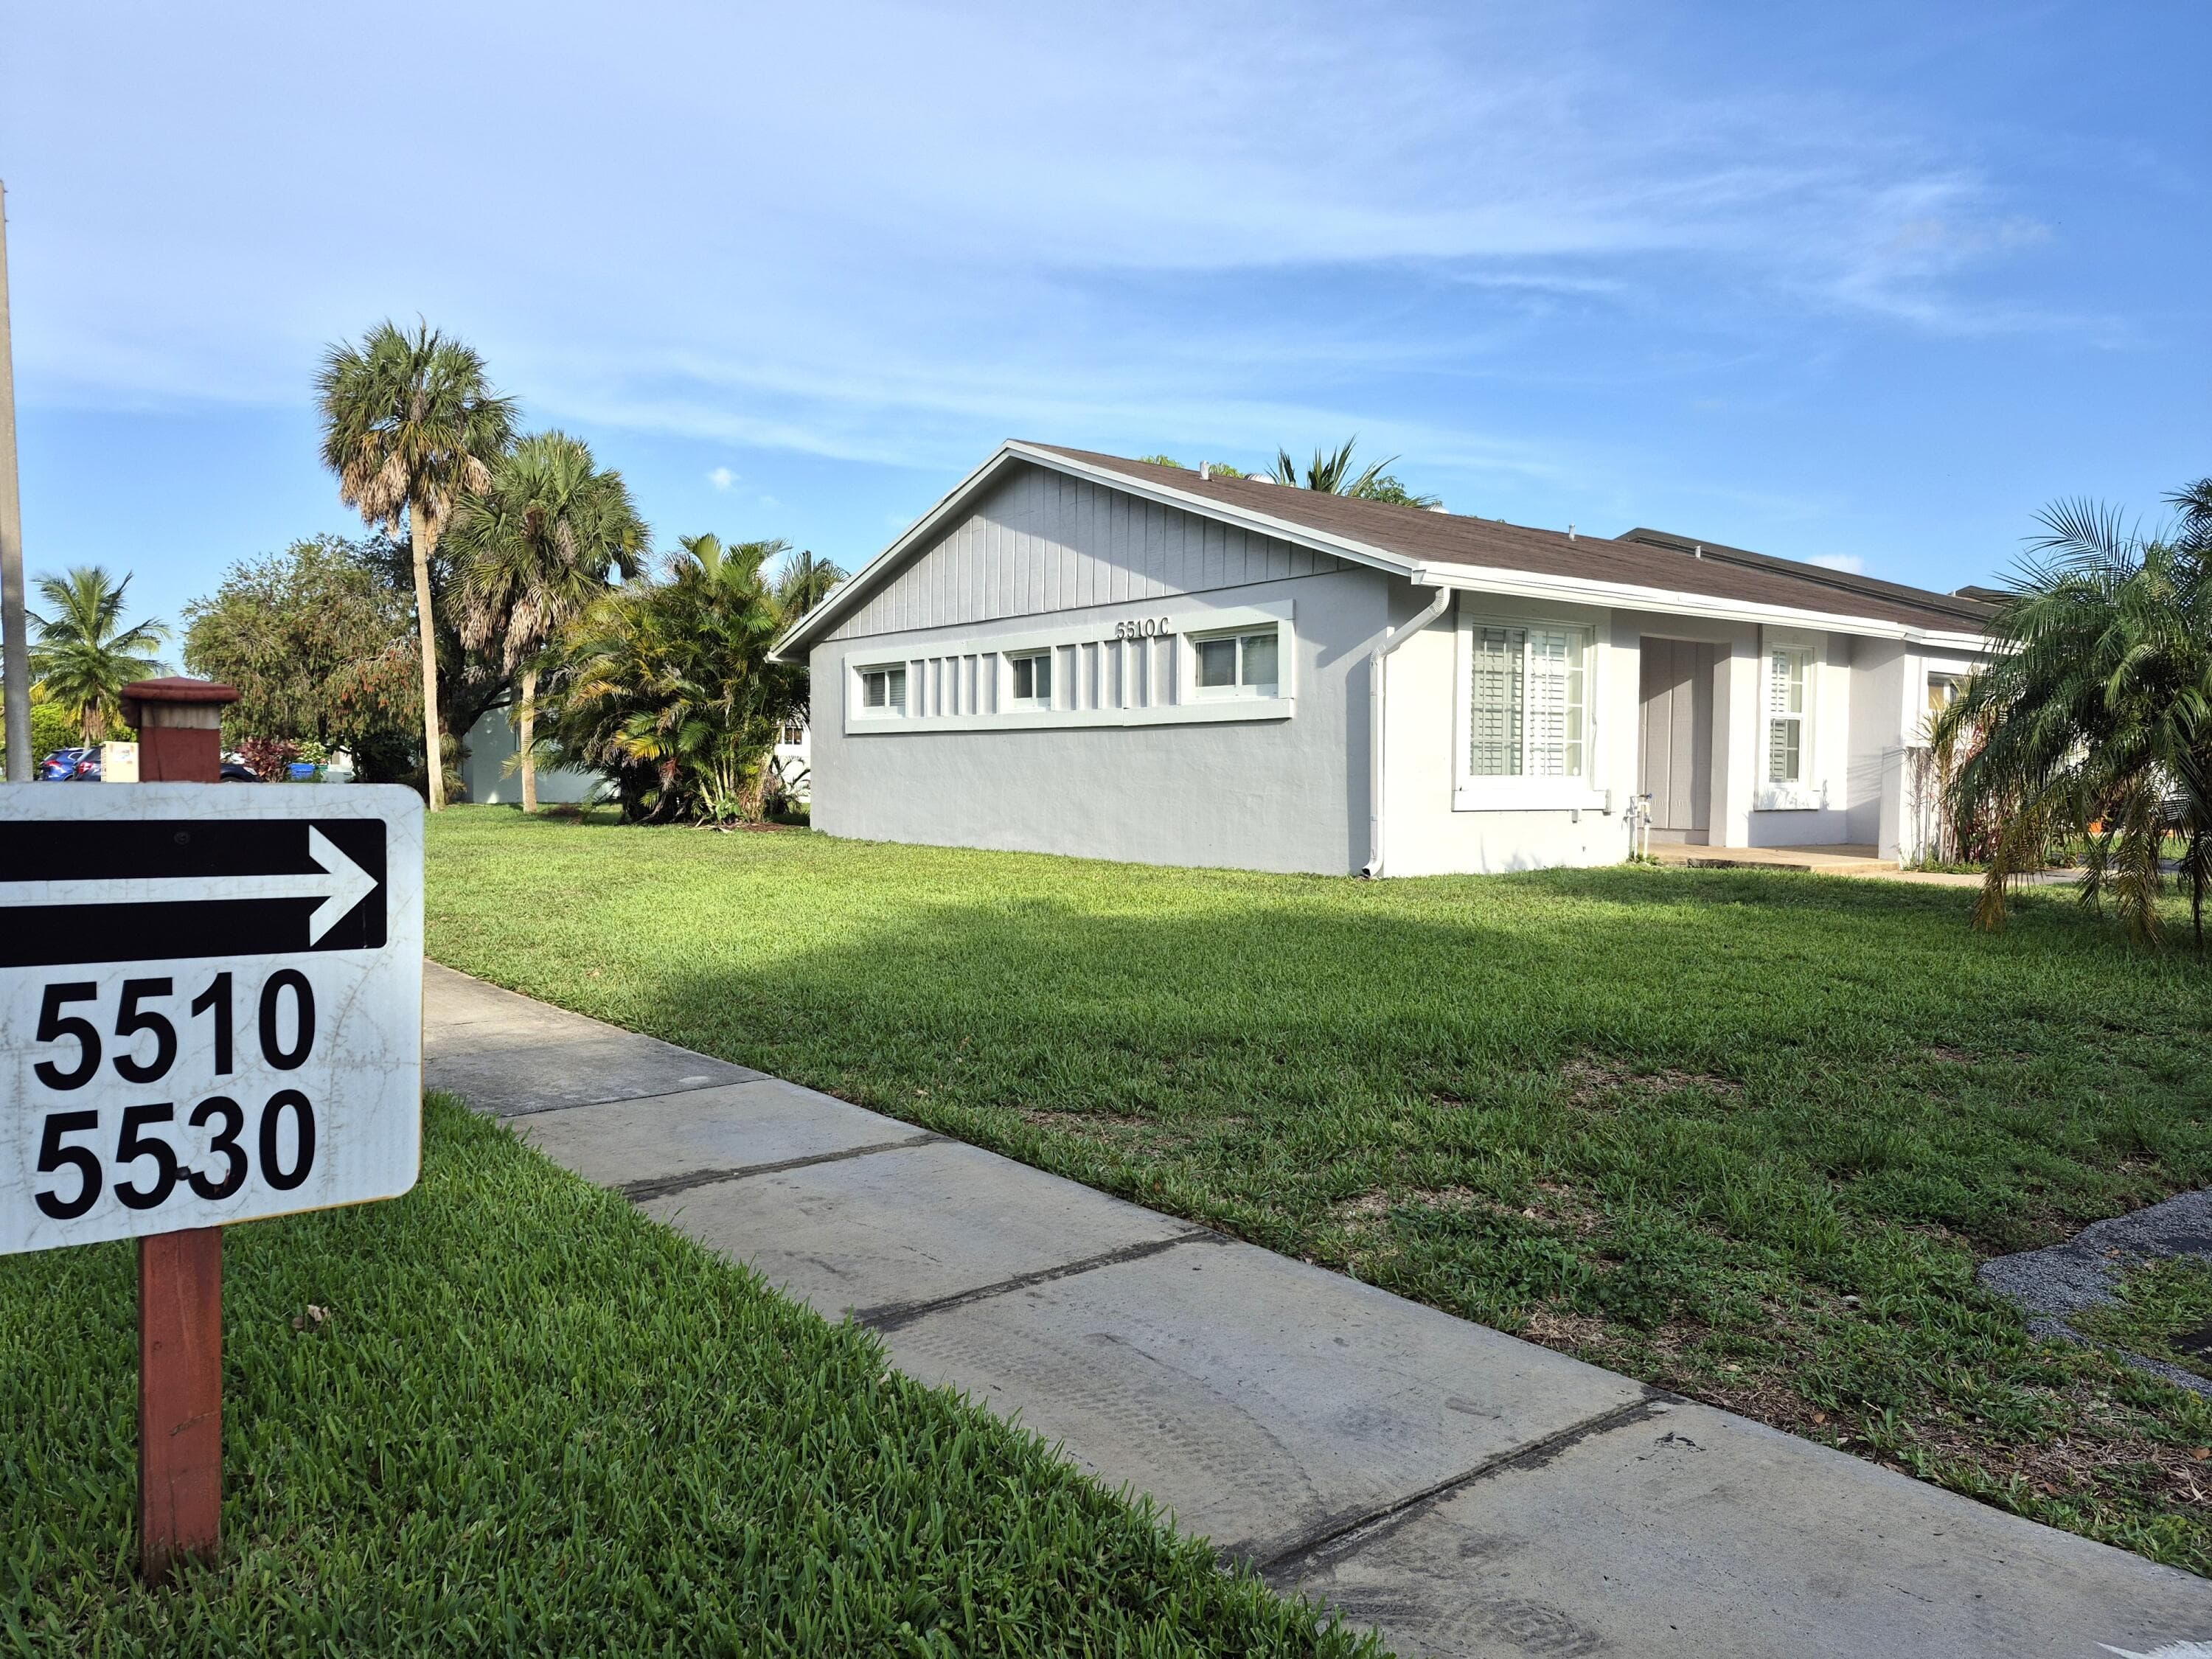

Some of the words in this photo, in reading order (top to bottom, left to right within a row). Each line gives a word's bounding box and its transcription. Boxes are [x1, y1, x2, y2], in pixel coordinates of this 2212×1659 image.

[1117, 619, 1155, 639] 5510
[1161, 616, 1169, 635] C
[34, 969, 316, 1091] 5510
[35, 1088, 316, 1220] 5530
